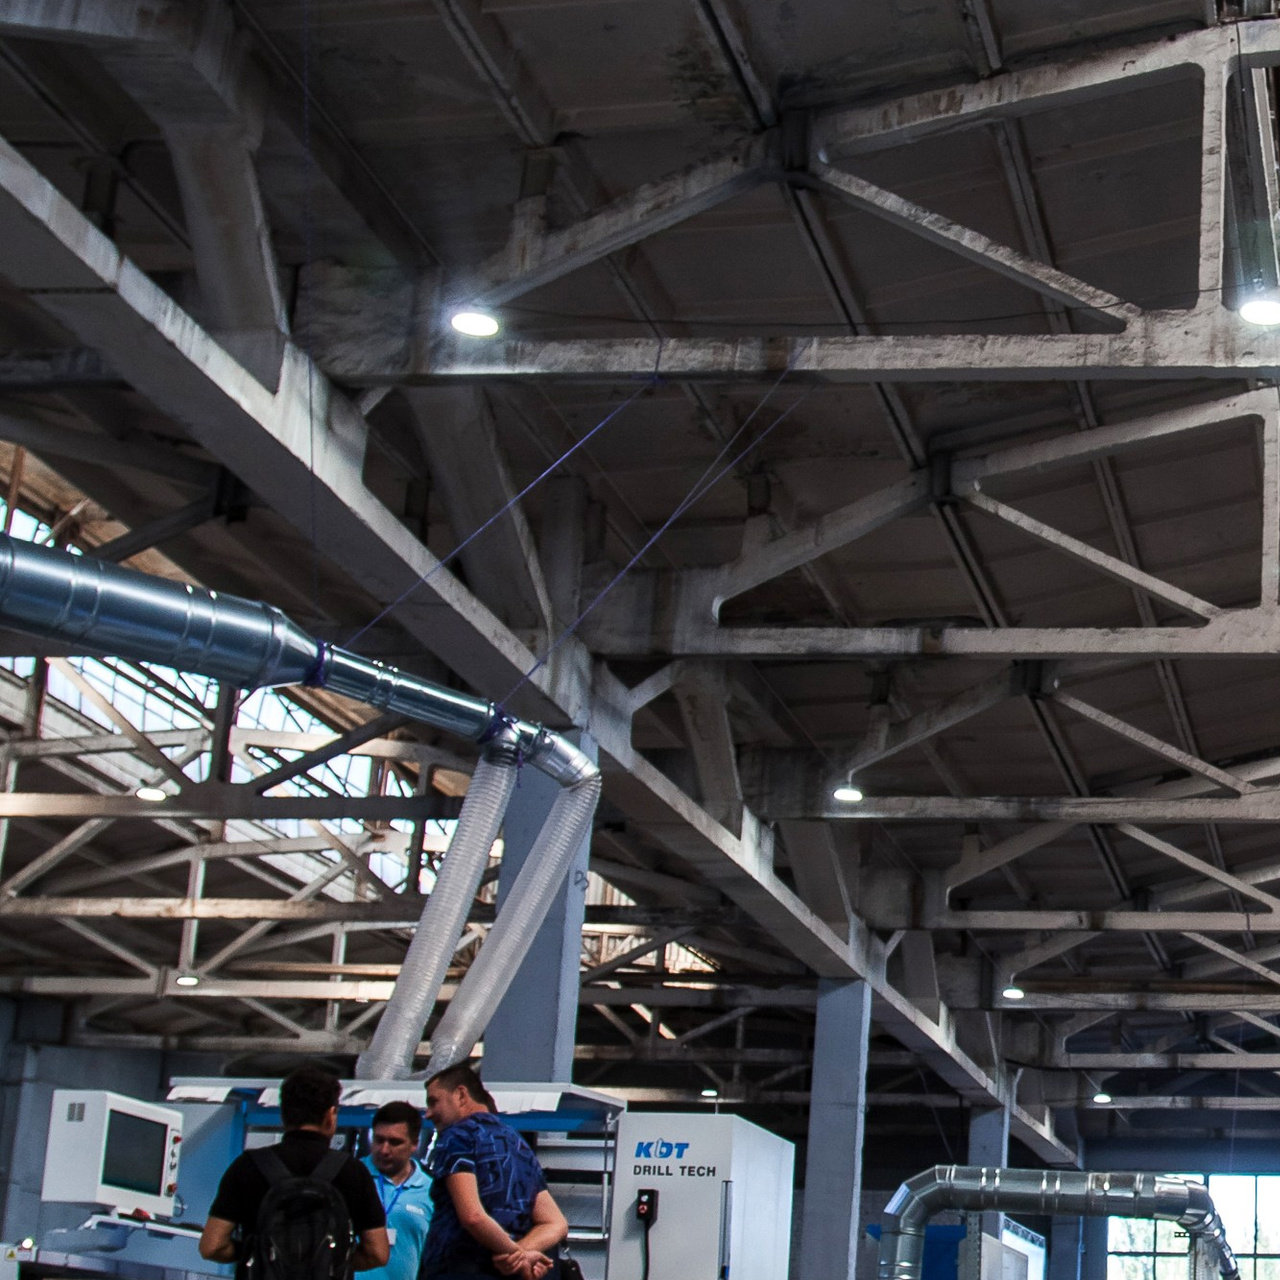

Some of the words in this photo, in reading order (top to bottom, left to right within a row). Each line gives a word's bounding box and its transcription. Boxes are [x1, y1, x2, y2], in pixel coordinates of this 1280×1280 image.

[634, 1137, 690, 1159] KDT
[633, 1165, 673, 1176] DRILL
[679, 1166, 716, 1177] TECH
